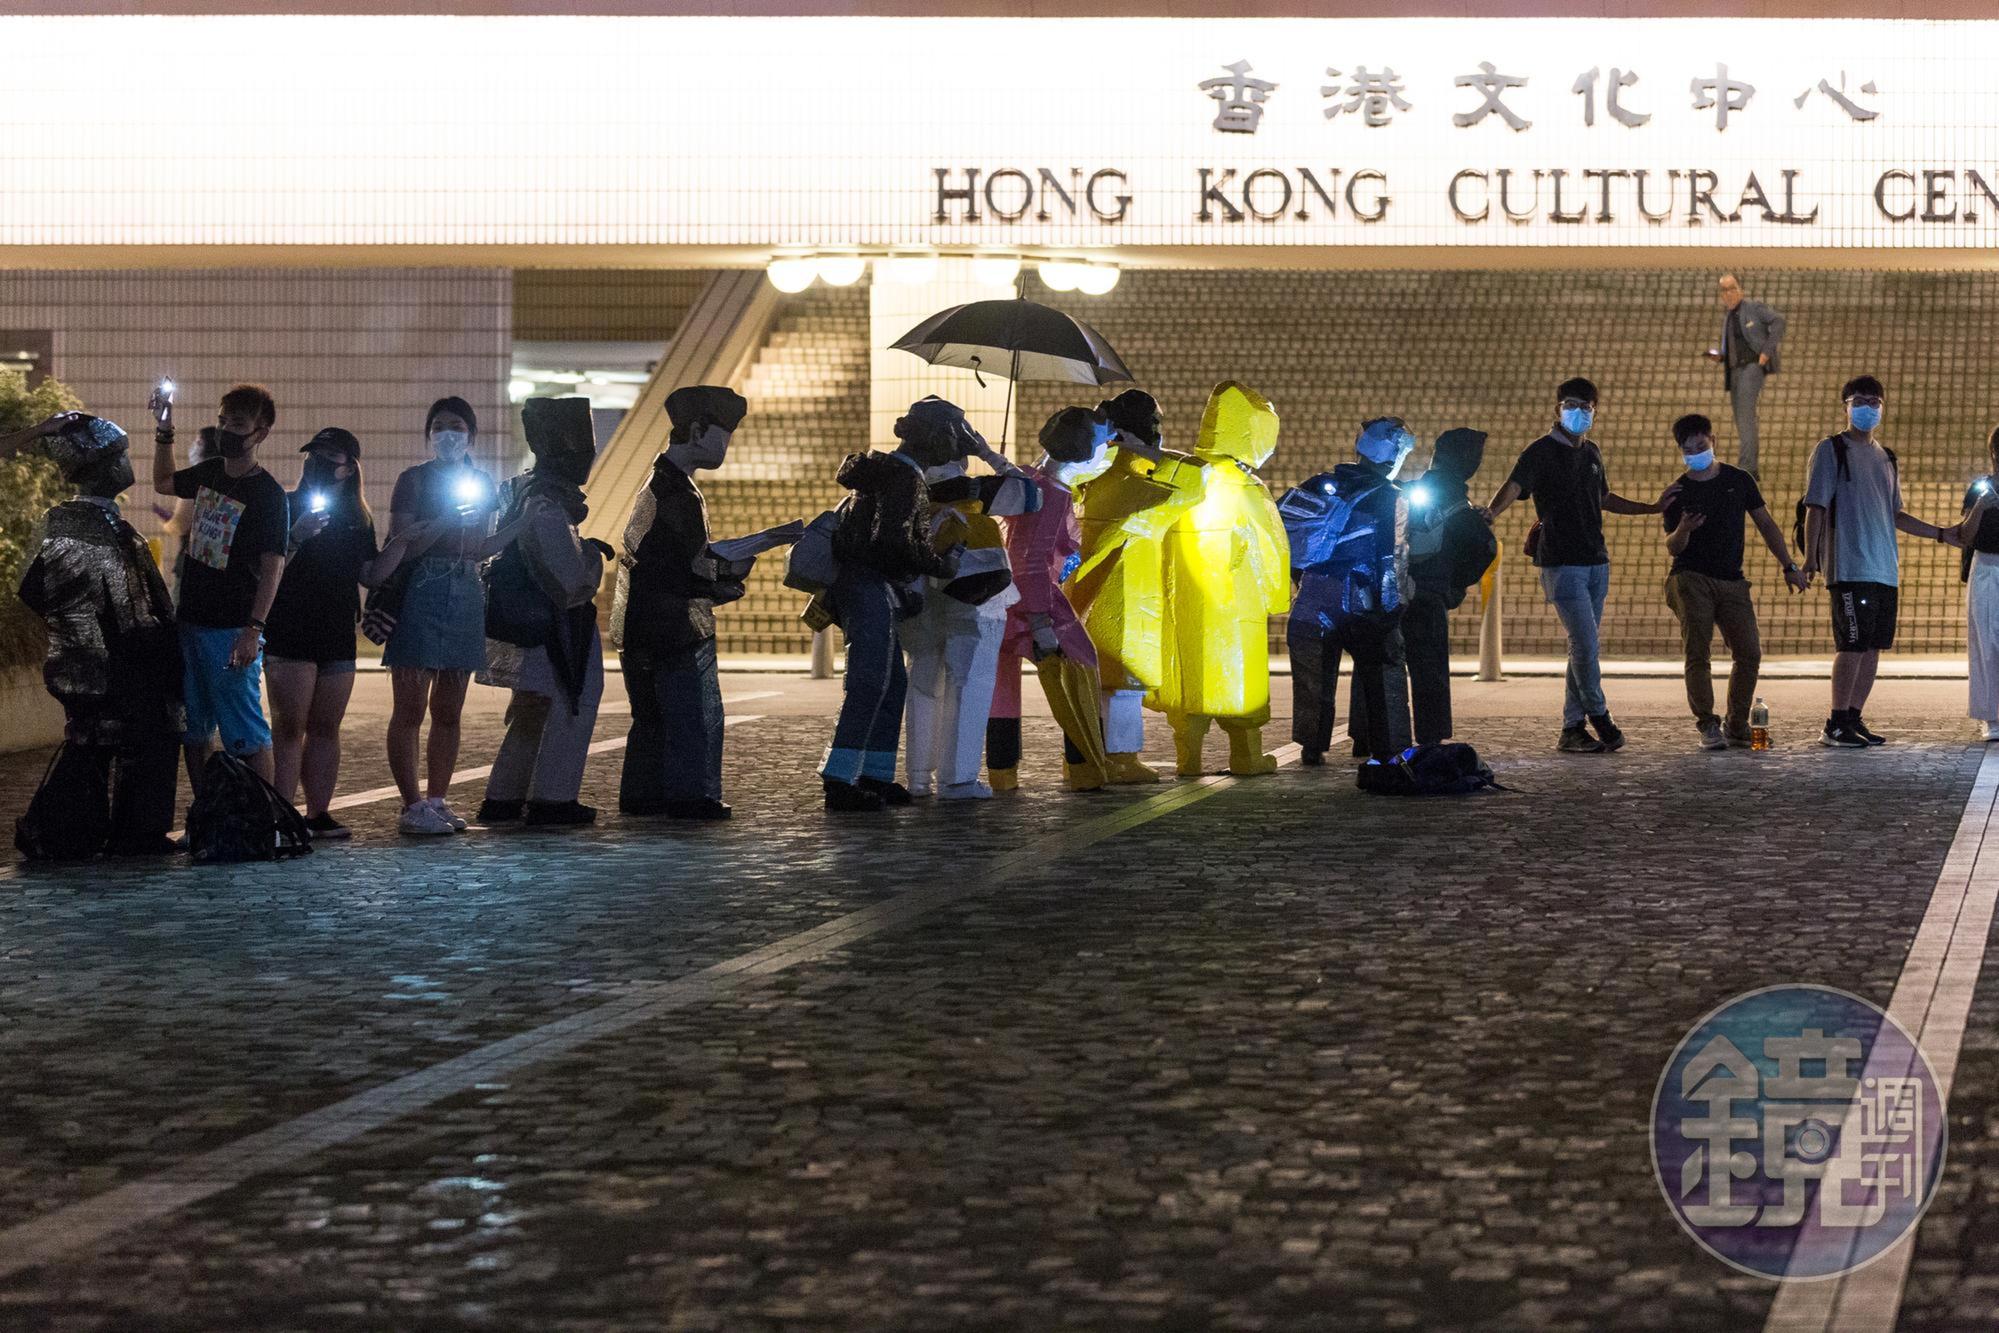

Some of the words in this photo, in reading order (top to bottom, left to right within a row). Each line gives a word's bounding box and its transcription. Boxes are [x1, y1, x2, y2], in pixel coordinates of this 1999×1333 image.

[1198, 61, 1880, 135] 香港文化中心
[934, 168, 1134, 224] HONG
[1193, 168, 1393, 223] KONG
[1448, 168, 1818, 224] CULTURAL
